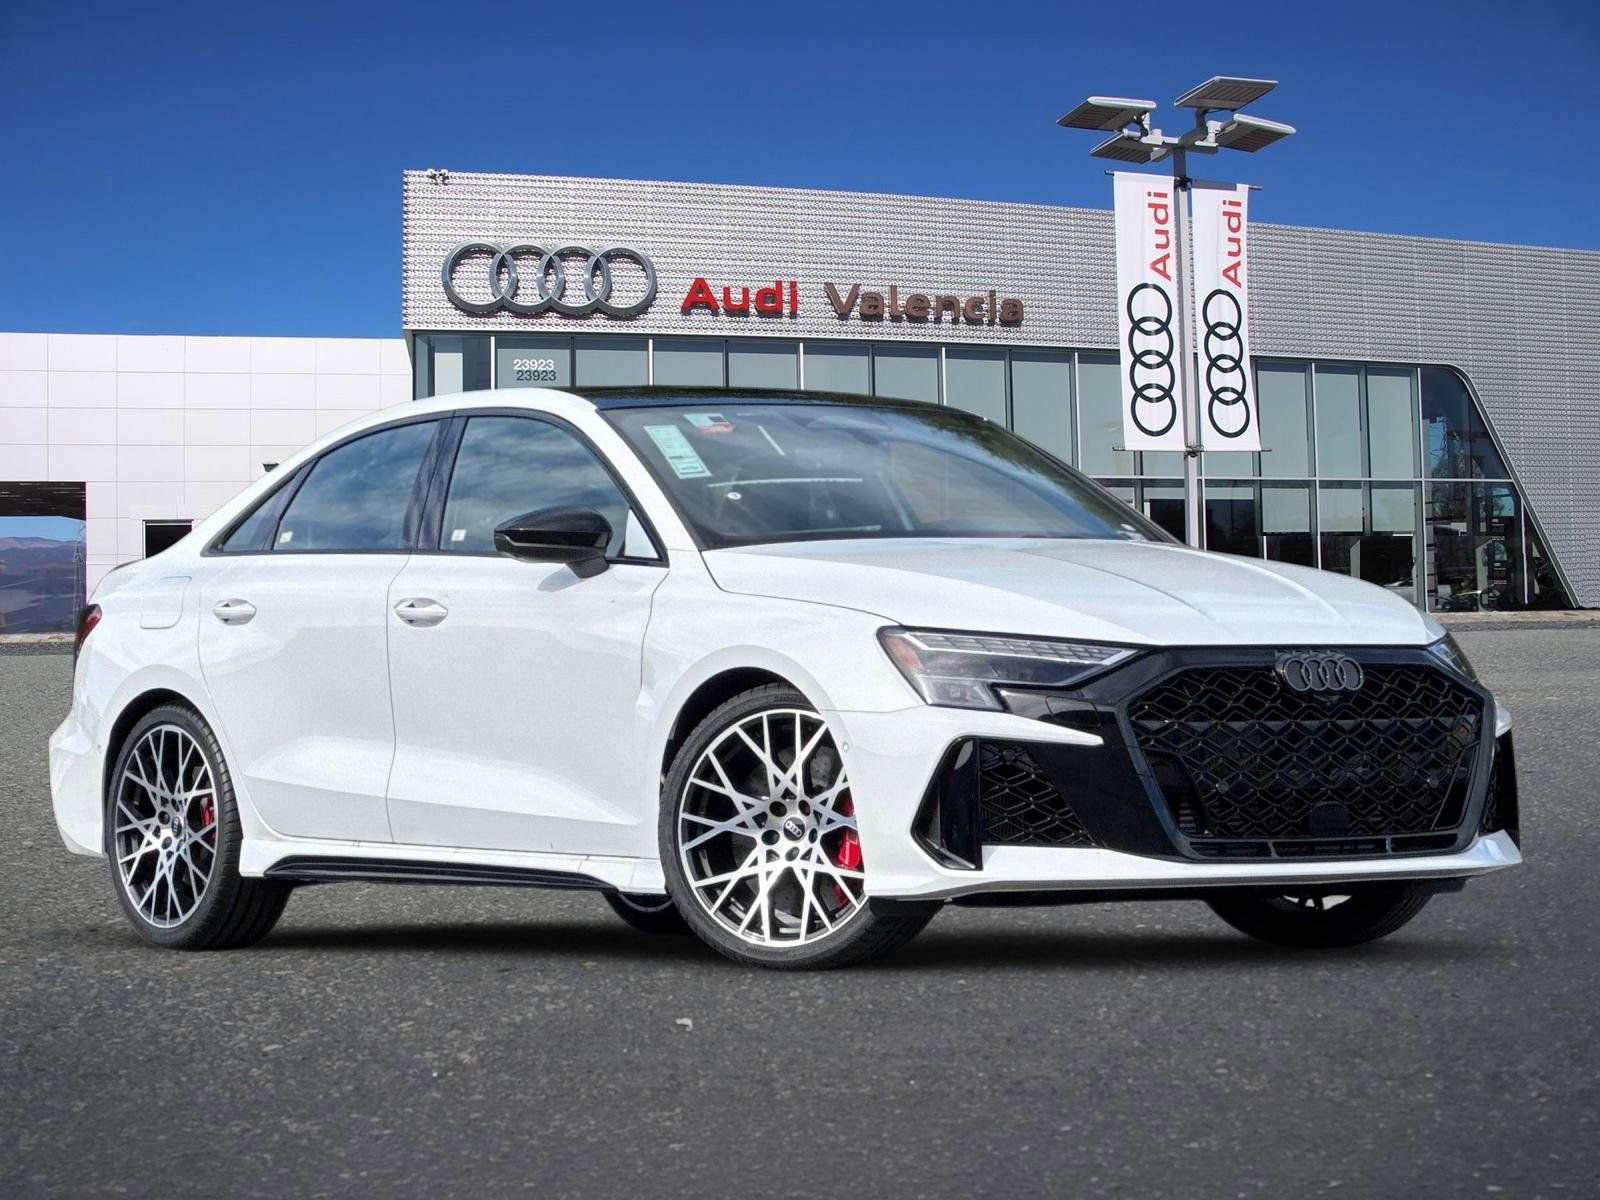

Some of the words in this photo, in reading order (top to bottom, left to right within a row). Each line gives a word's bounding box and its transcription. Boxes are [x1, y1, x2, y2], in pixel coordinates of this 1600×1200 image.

[1147, 190, 1171, 281] Audi
[1222, 198, 1242, 288] Audi
[681, 277, 798, 316] Audi
[824, 282, 1024, 324] Valencia
[513, 359, 554, 371] 23923
[516, 370, 557, 381] 23923
